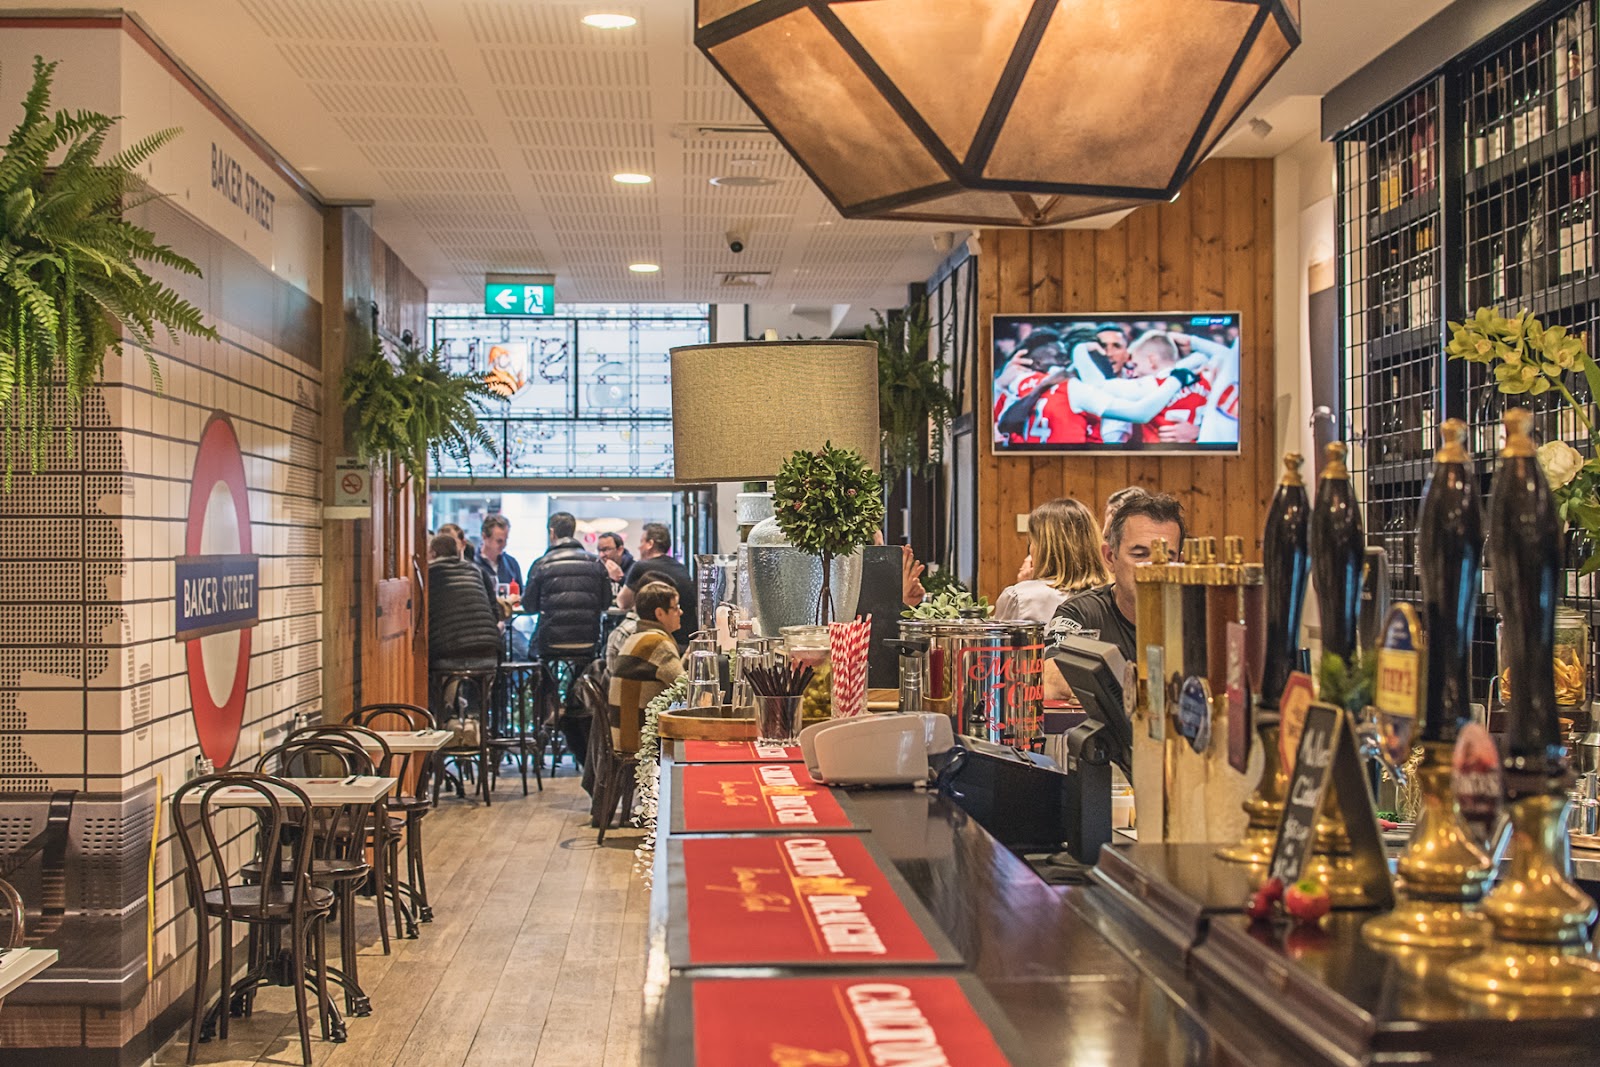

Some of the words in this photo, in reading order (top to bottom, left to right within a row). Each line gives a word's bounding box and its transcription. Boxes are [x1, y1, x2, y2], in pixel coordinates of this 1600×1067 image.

[211, 141, 243, 211] BAKER
[245, 172, 275, 232] STREET
[183, 577, 219, 618] BAKER
[222, 573, 254, 612] STREET
[1060, 619, 1080, 630] FIRE
